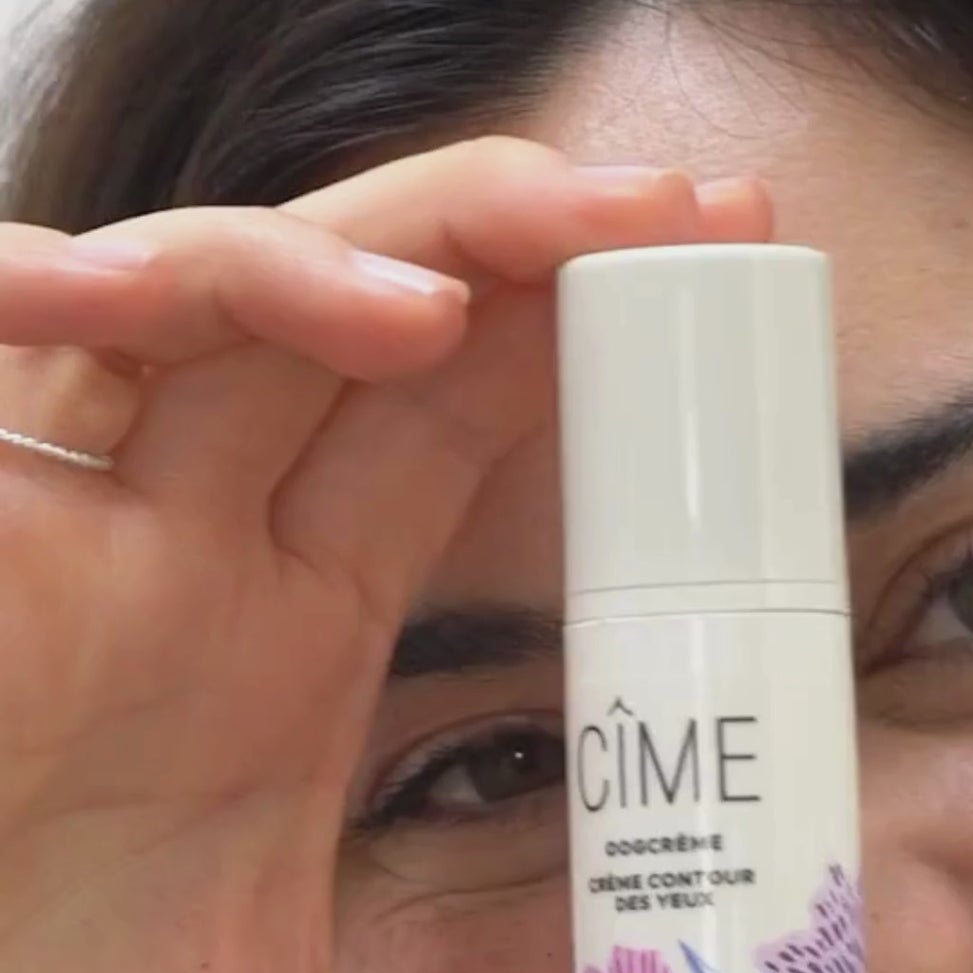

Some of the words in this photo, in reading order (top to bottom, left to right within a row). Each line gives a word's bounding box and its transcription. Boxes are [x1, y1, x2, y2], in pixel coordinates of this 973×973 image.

[578, 697, 761, 812] CÎME
[647, 869, 755, 888] CONTOUR
[615, 894, 650, 912] DES
[656, 892, 714, 909] YEUX
